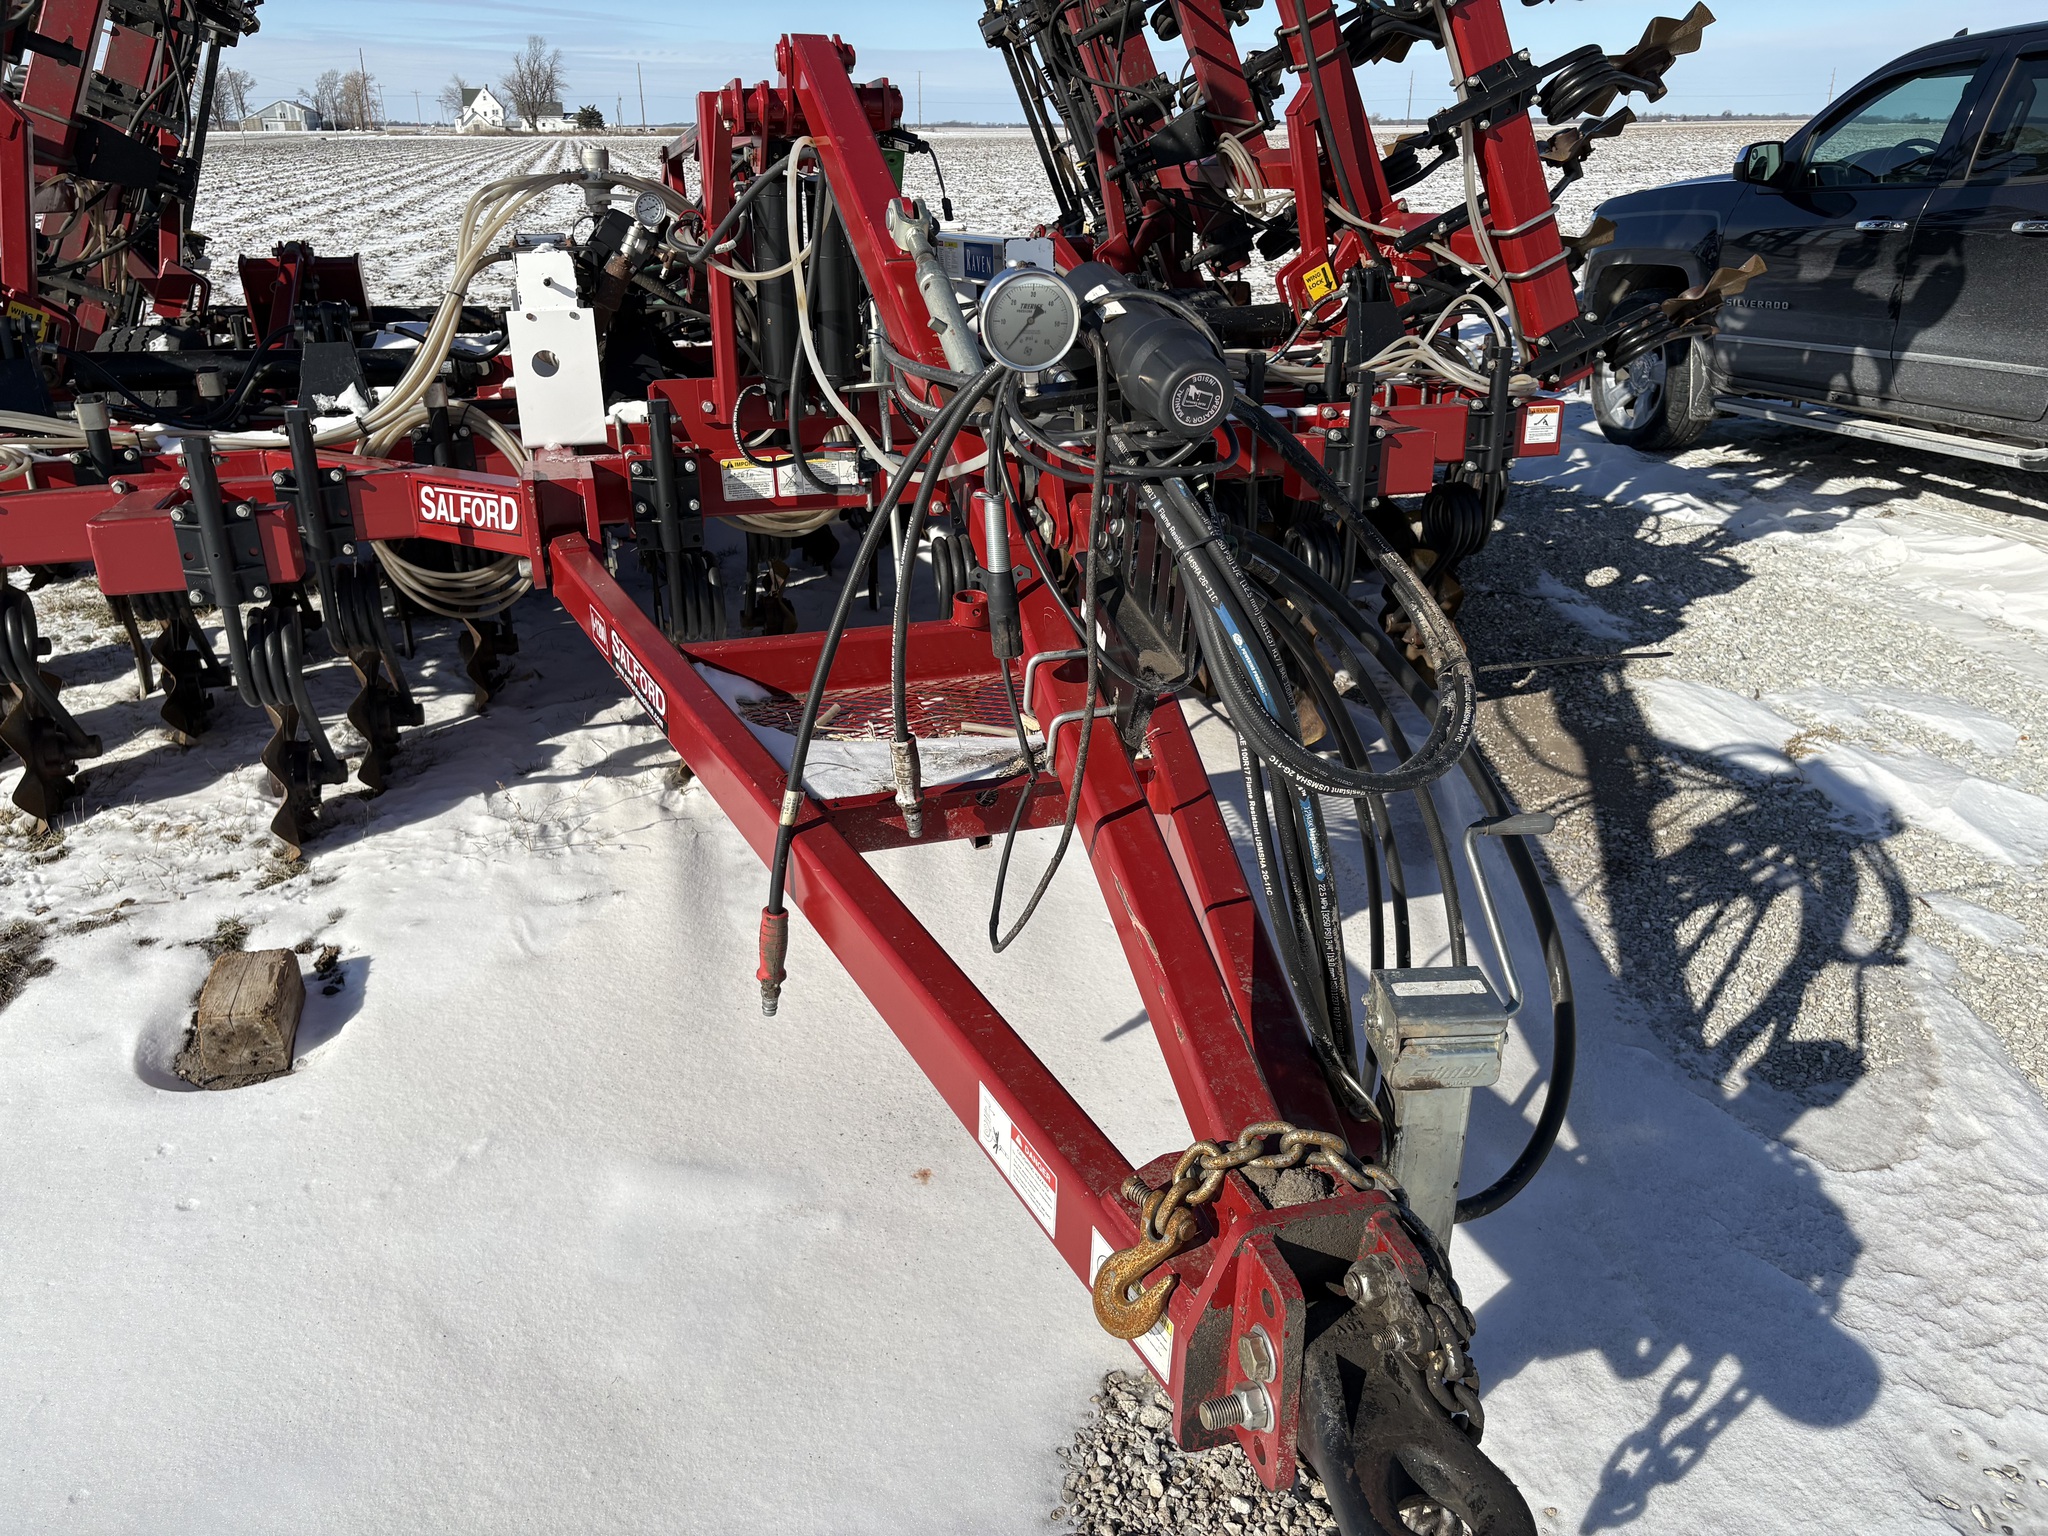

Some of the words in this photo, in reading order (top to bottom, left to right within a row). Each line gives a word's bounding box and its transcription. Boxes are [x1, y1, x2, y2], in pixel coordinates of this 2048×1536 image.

[1305, 271, 1322, 283] WING
[1309, 279, 1325, 290] LOCK
[1726, 298, 1789, 310] SILVERADO
[1192, 375, 1216, 386] INSIDE
[1174, 389, 1185, 418] MANUAL
[1185, 395, 1221, 424] OPERATOR'S
[421, 485, 518, 531] SALFORD
[1157, 507, 1171, 528] Flame
[1168, 525, 1189, 557] Resistat
[1186, 554, 1201, 576] MSHA
[1198, 575, 1218, 602] 2G-11C
[611, 629, 666, 716] SALFORD
[1454, 724, 1467, 742] 2G-11C
[1241, 747, 1250, 774] 100R17
[1268, 754, 1295, 776] 2G-11C
[1245, 776, 1253, 799] Flame
[1295, 773, 1329, 792] USMSHA
[1248, 800, 1260, 834] Resistant
[1254, 836, 1266, 868] USMSHA
[1261, 869, 1273, 895] 2G-11C
[1317, 883, 1327, 896] 22.5
[1320, 897, 1328, 909] MPa
[1024, 1144, 1052, 1184] DANGER
